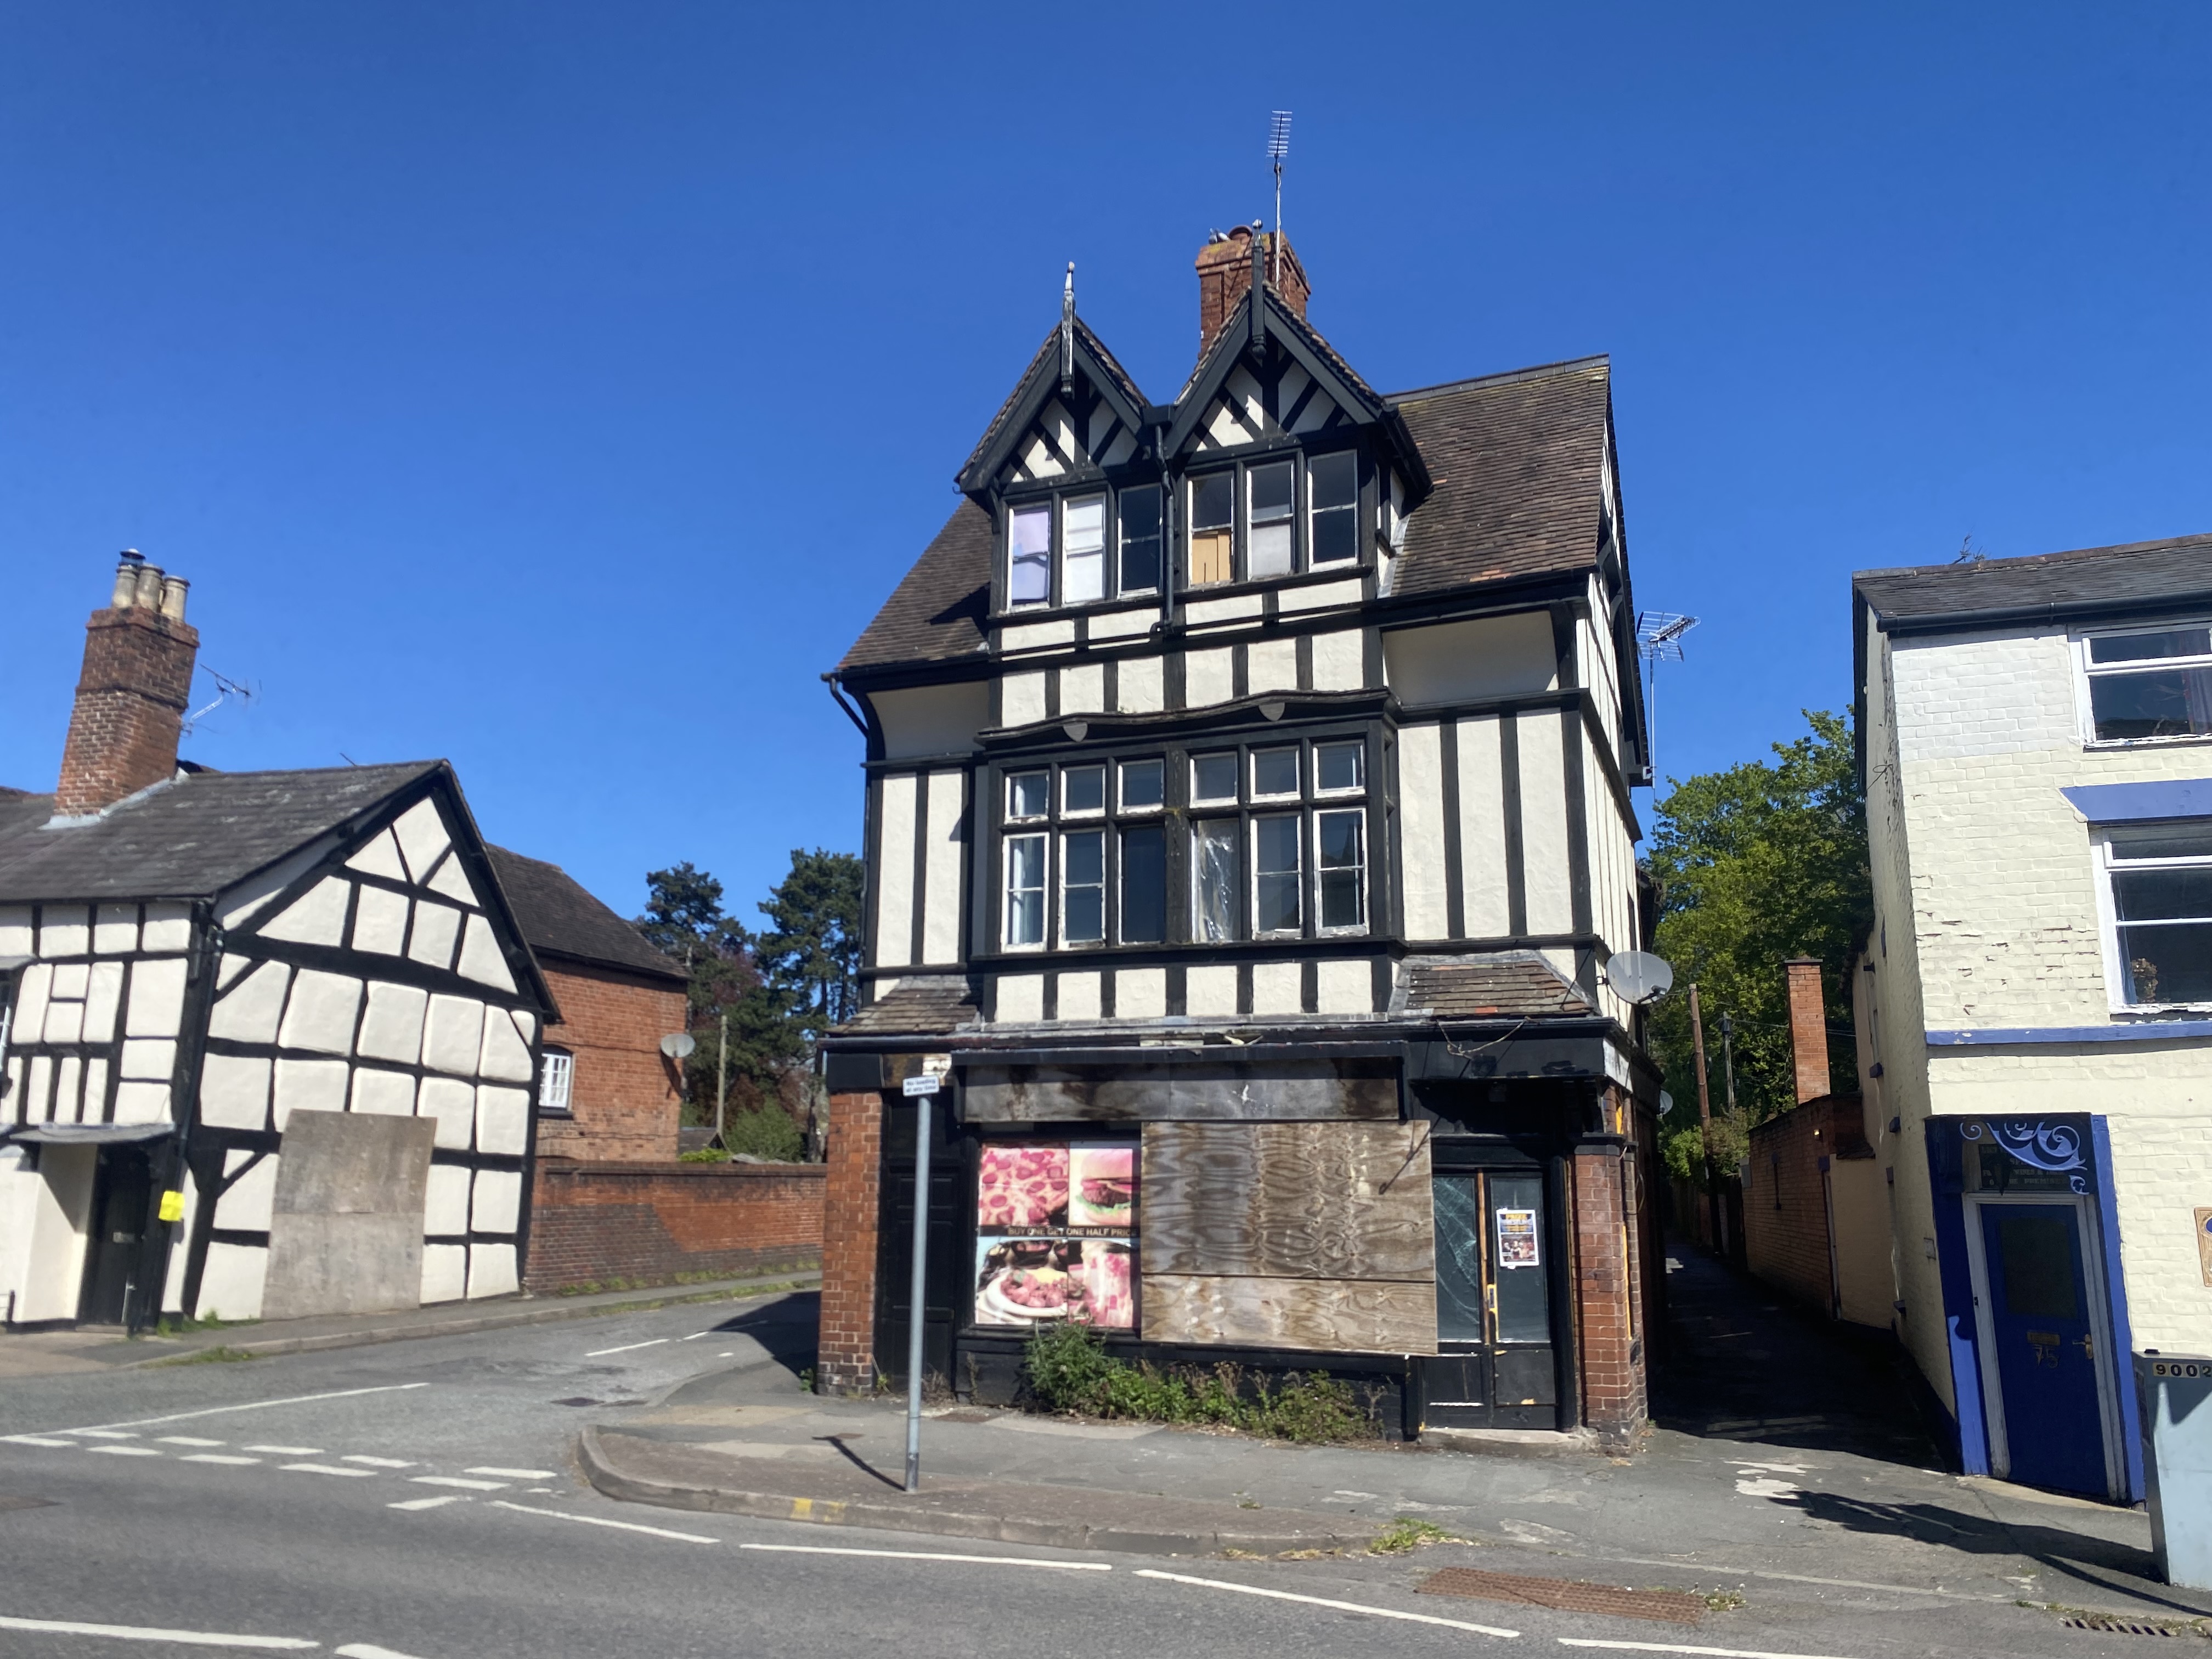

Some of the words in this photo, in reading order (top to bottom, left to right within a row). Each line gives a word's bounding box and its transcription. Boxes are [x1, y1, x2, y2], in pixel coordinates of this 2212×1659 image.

[1008, 1227, 1025, 1235] BUY
[1027, 1227, 1046, 1236] ONE
[1047, 1227, 1064, 1235] GET
[1086, 1228, 1109, 1236] HALF
[2155, 1364, 2212, 1378] 9002
